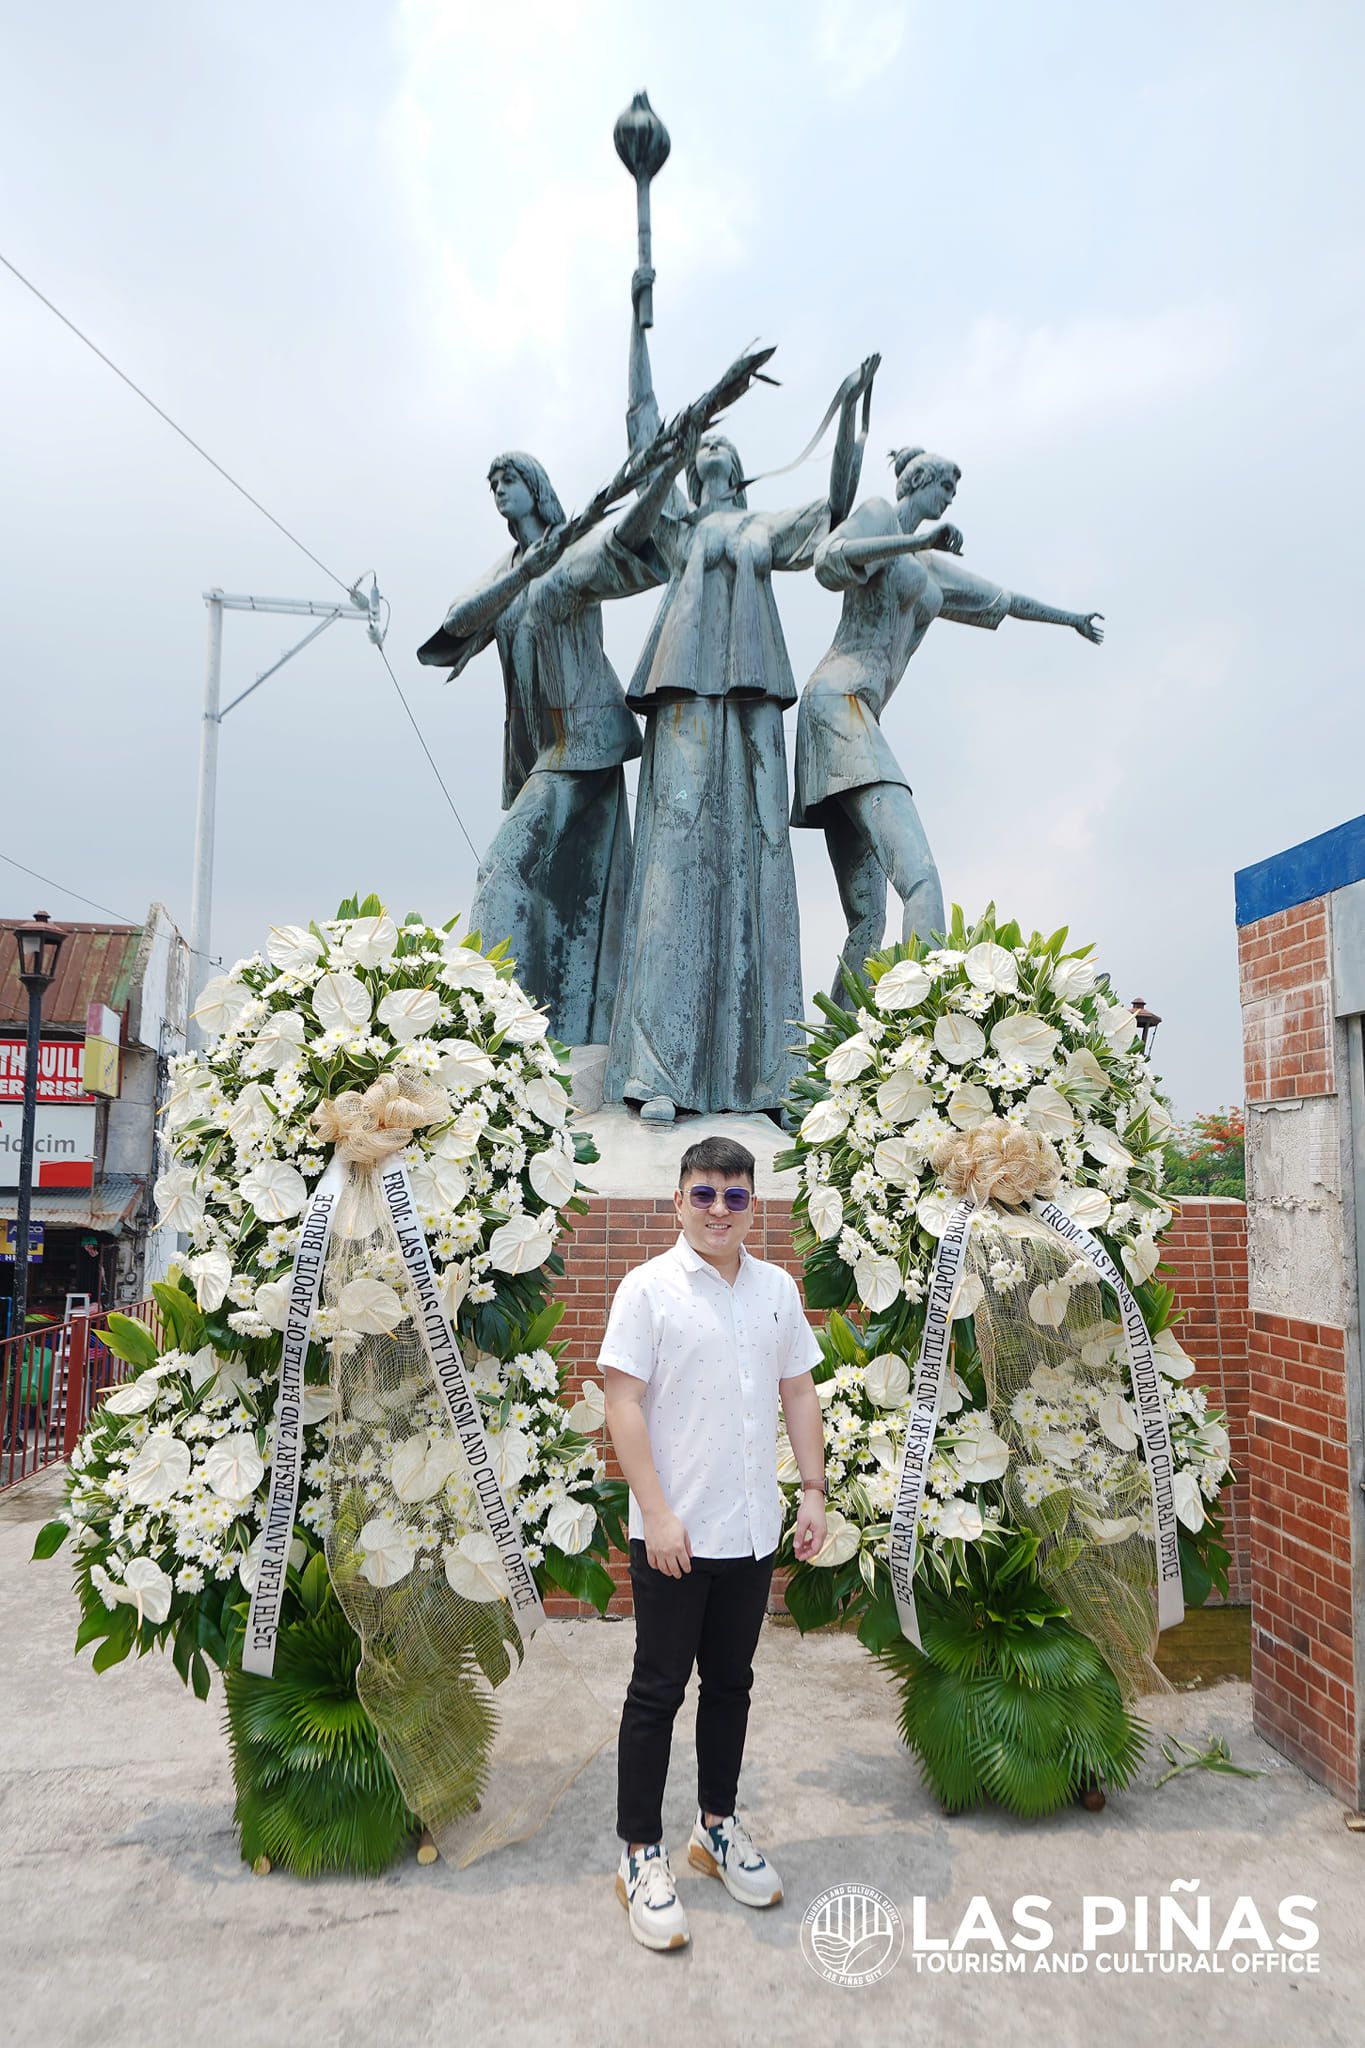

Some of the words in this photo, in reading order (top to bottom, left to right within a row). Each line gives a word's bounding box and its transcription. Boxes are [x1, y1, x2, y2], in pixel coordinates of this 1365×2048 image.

[0, 1134, 75, 1153] Hocim
[382, 1170, 413, 1224] FROM:
[301, 1193, 334, 1252] BRIDGE
[397, 1225, 423, 1259] LAS
[943, 1198, 976, 1245] BRIDGE
[1040, 1203, 1084, 1244] FROM:
[932, 1246, 960, 1304] ZAPOTE
[1083, 1240, 1110, 1268] LAS
[289, 1254, 320, 1318] ZAPOTE
[406, 1259, 438, 1312] PINAS
[1105, 1266, 1136, 1313] PINAS
[286, 1319, 307, 1341] OF
[425, 1313, 452, 1352] CITY
[929, 1302, 948, 1325] OF
[1127, 1313, 1149, 1348] CITY
[282, 1344, 303, 1404] BATTLE
[920, 1325, 945, 1381] BATTLE
[435, 1352, 477, 1430] TOURISM
[916, 1382, 937, 1413] 2ND
[1133, 1350, 1161, 1415] TOURISM
[279, 1406, 299, 1440] 2ND
[1143, 1418, 1167, 1451] AND
[460, 1432, 488, 1466] AND
[896, 1413, 931, 1520] ANNIVERSARY
[265, 1441, 297, 1556] ANNIVERSARY
[473, 1467, 516, 1550] CULTURAL
[1150, 1454, 1175, 1531] CULTURAL
[891, 1522, 914, 1562] YEAR
[1160, 1531, 1179, 1582] OFFICE
[256, 1559, 283, 1601] YEAR
[502, 1552, 537, 1611] OFFICE
[892, 1562, 912, 1606] 125TH
[253, 1604, 278, 1650] 125TH
